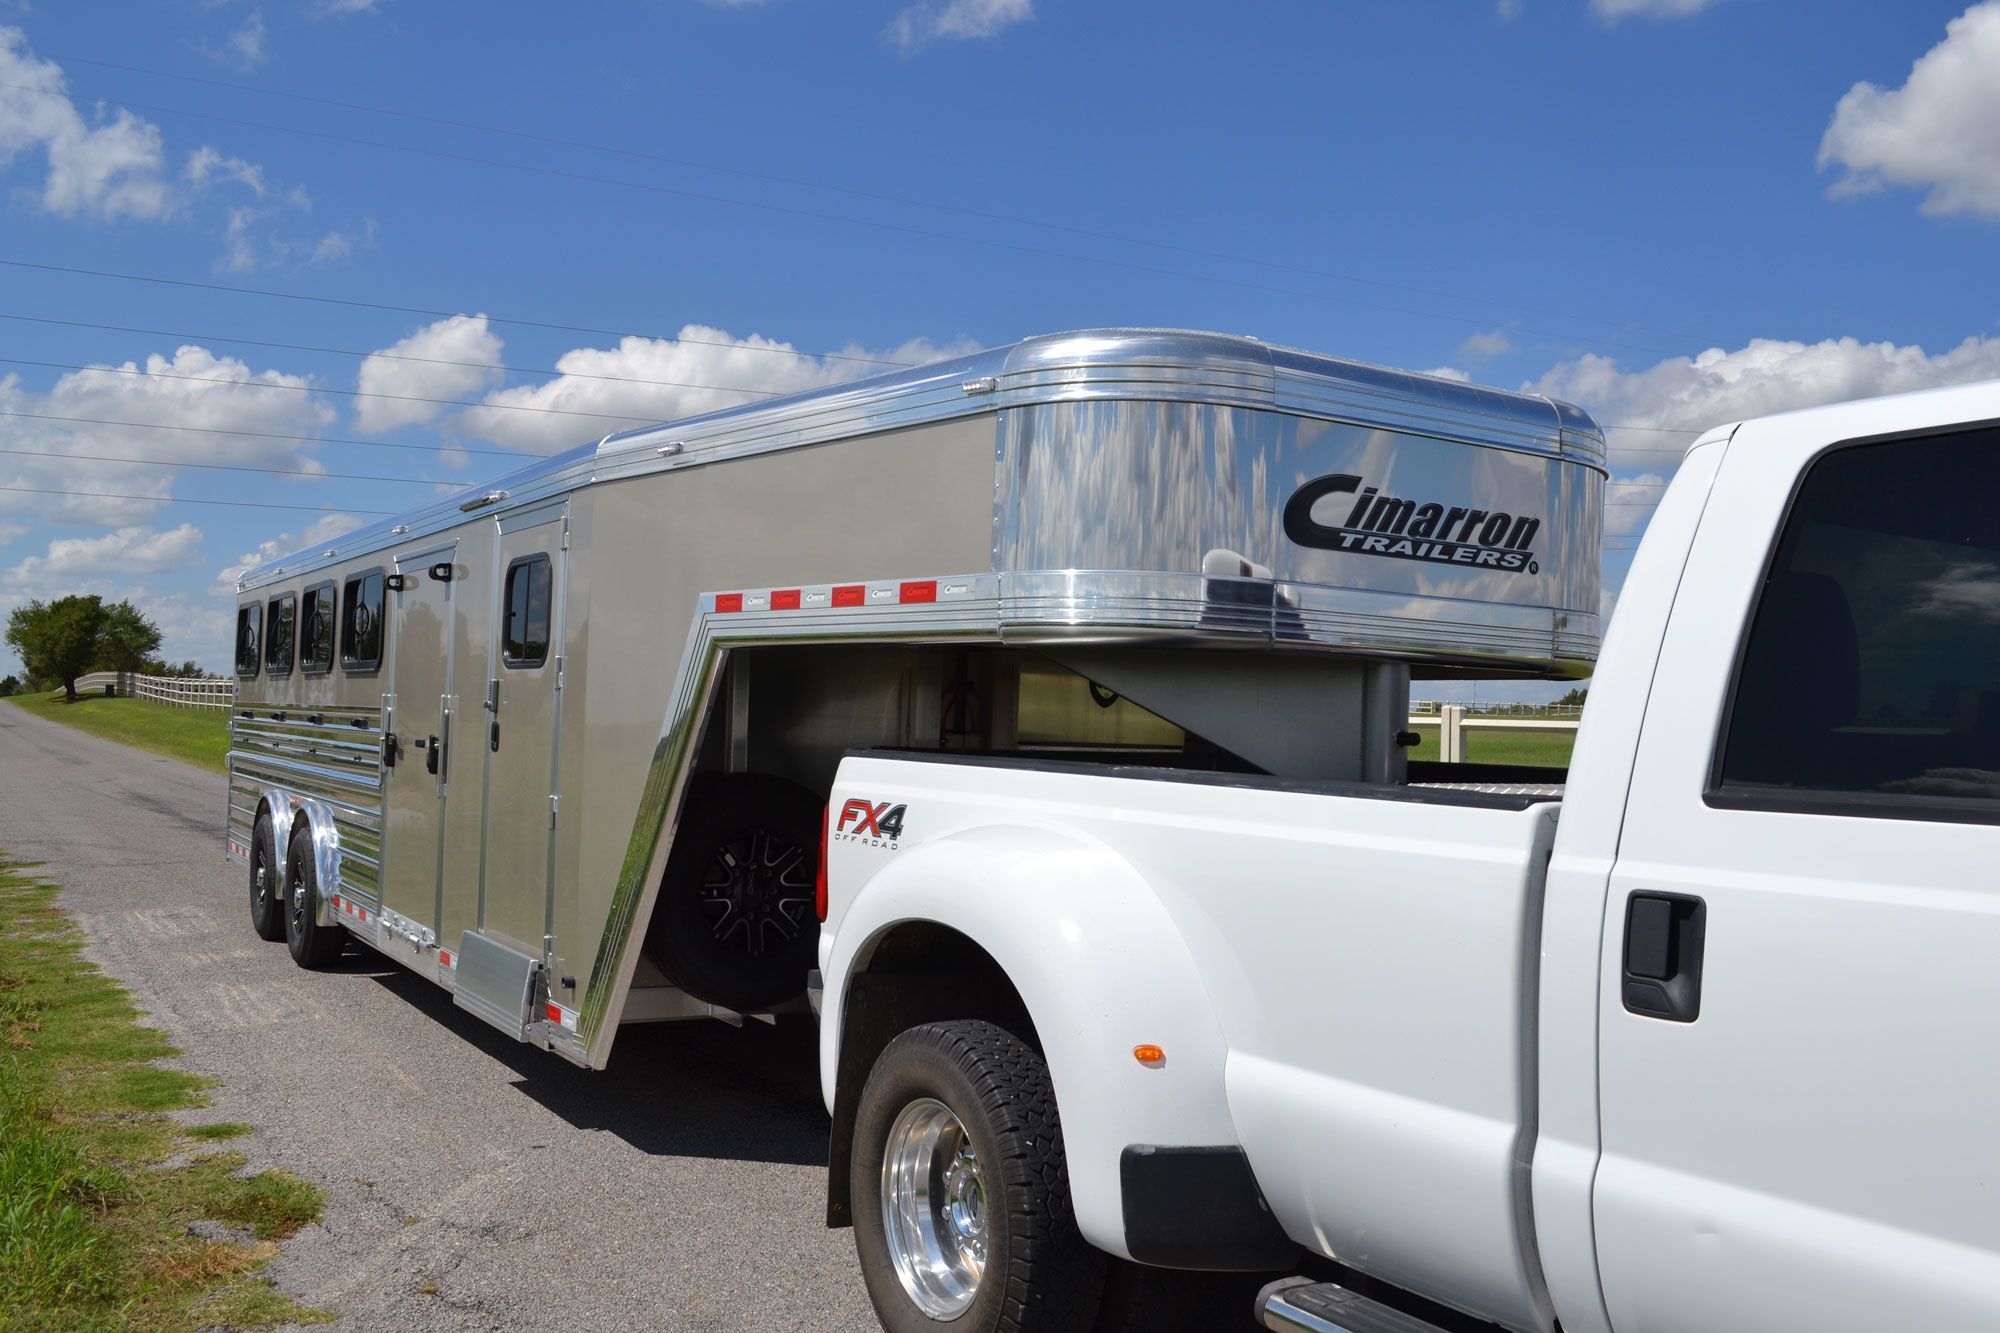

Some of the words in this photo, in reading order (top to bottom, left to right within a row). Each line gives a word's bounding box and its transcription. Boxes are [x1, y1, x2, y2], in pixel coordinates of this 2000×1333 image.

[1283, 473, 1541, 550] Cimarron
[1338, 532, 1525, 568] TRAILERS
[837, 798, 907, 840] FX4
[834, 833, 857, 843] OFF
[861, 838, 898, 850] ROAD
